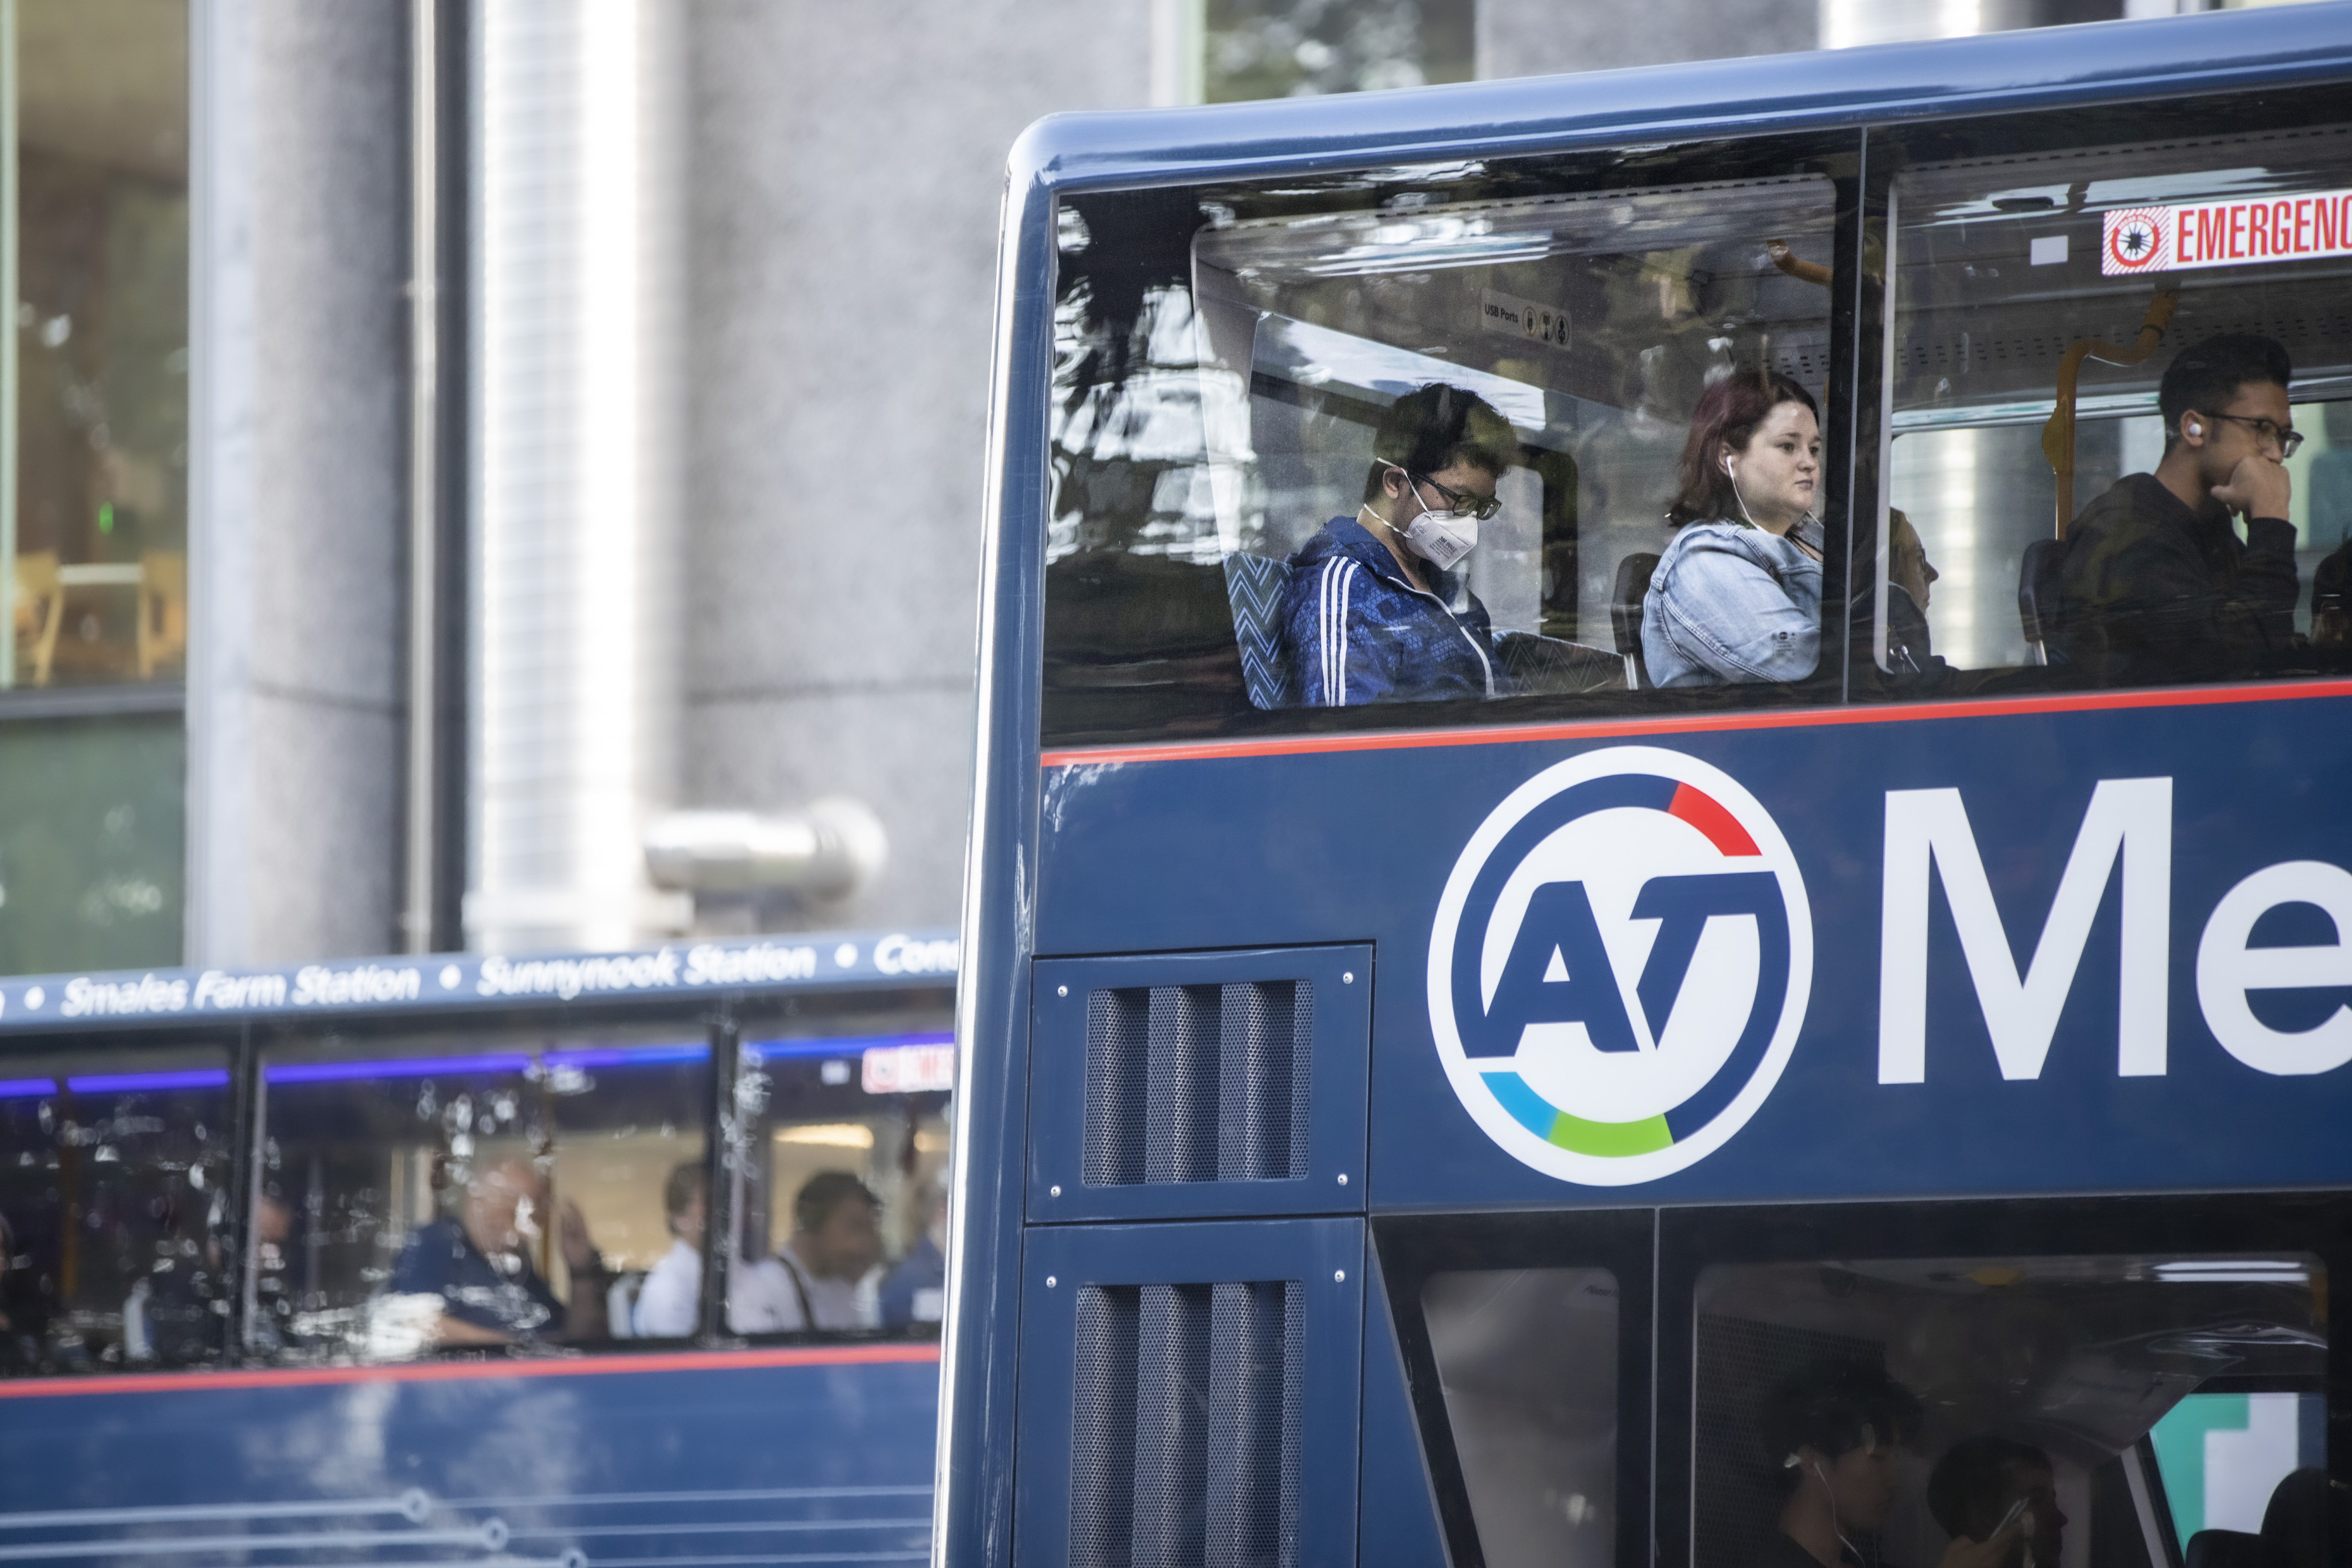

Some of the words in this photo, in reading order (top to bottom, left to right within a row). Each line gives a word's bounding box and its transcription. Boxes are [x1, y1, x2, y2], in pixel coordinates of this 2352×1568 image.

[1485, 303, 1498, 317] USB
[1501, 307, 1518, 323] Ports
[60, 973, 189, 1017] Smales
[193, 971, 287, 1009] Farm
[291, 965, 421, 1005] Station
[476, 946, 681, 1000] Sunnynook
[683, 942, 816, 984] Station
[1467, 870, 1776, 1059] AT
[1878, 776, 2352, 1084] Me
